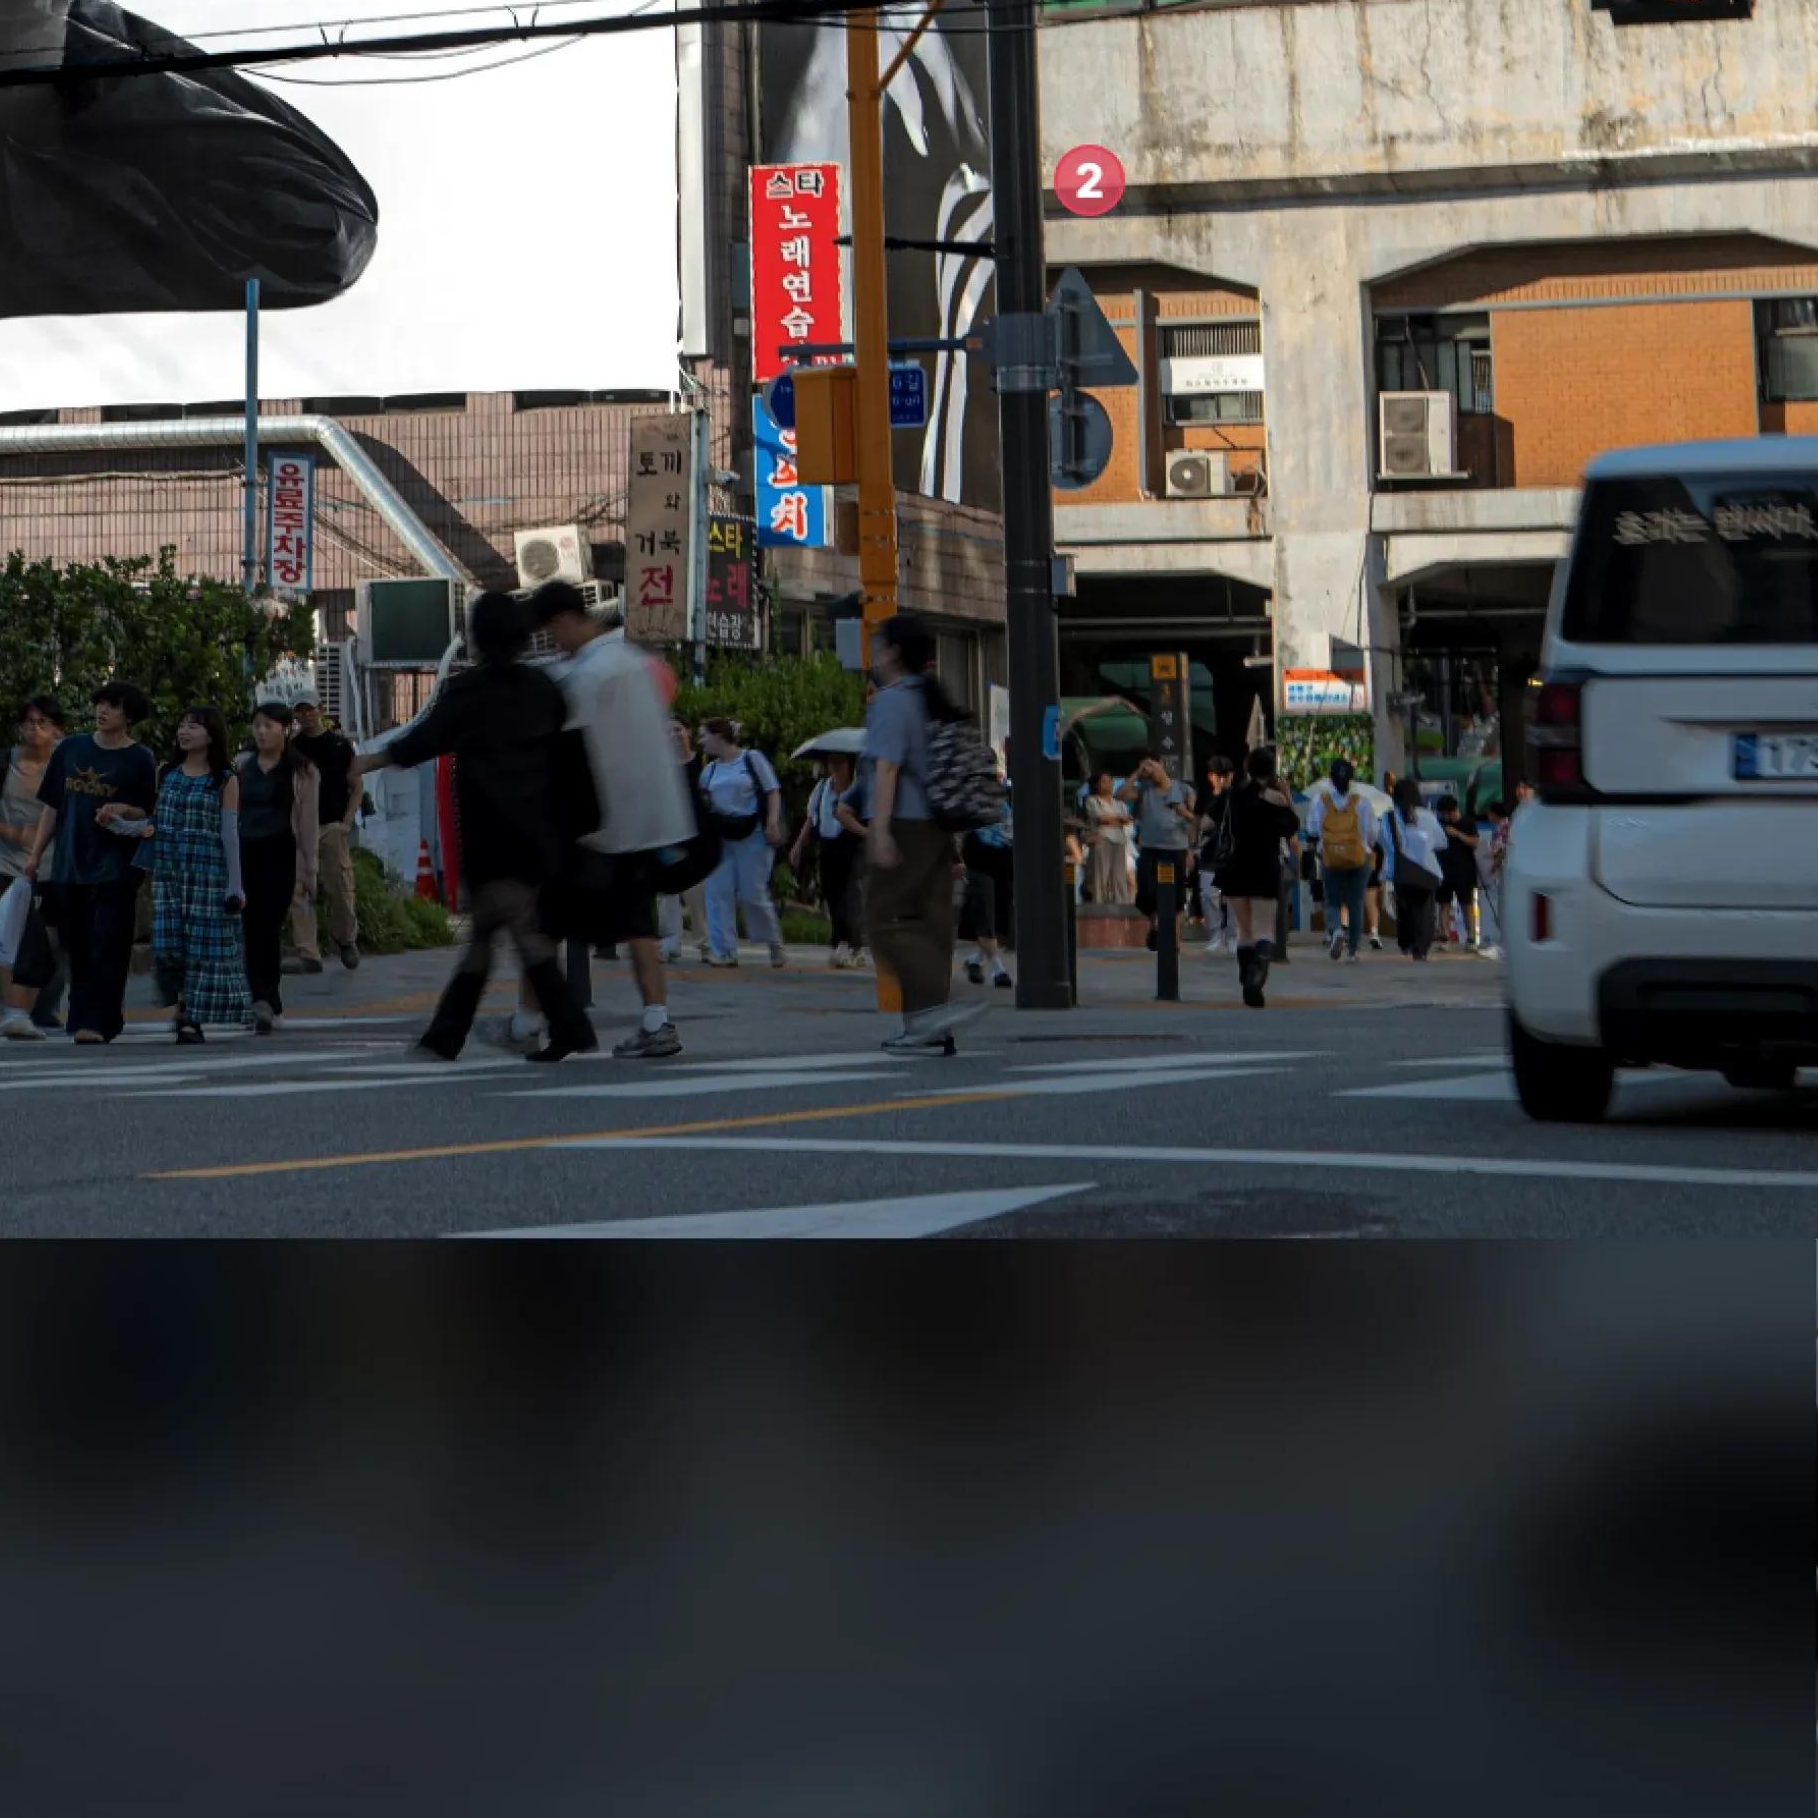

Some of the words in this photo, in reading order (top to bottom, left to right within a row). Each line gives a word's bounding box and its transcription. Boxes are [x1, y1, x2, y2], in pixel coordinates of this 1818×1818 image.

[766, 169, 825, 199] 스타
[778, 204, 816, 366] 노래연습
[636, 450, 682, 476] 토끼
[664, 492, 681, 510] 와
[273, 463, 307, 584] 유료주차장
[708, 520, 743, 559] 스타
[635, 529, 682, 556] 거북
[640, 565, 674, 607] 전
